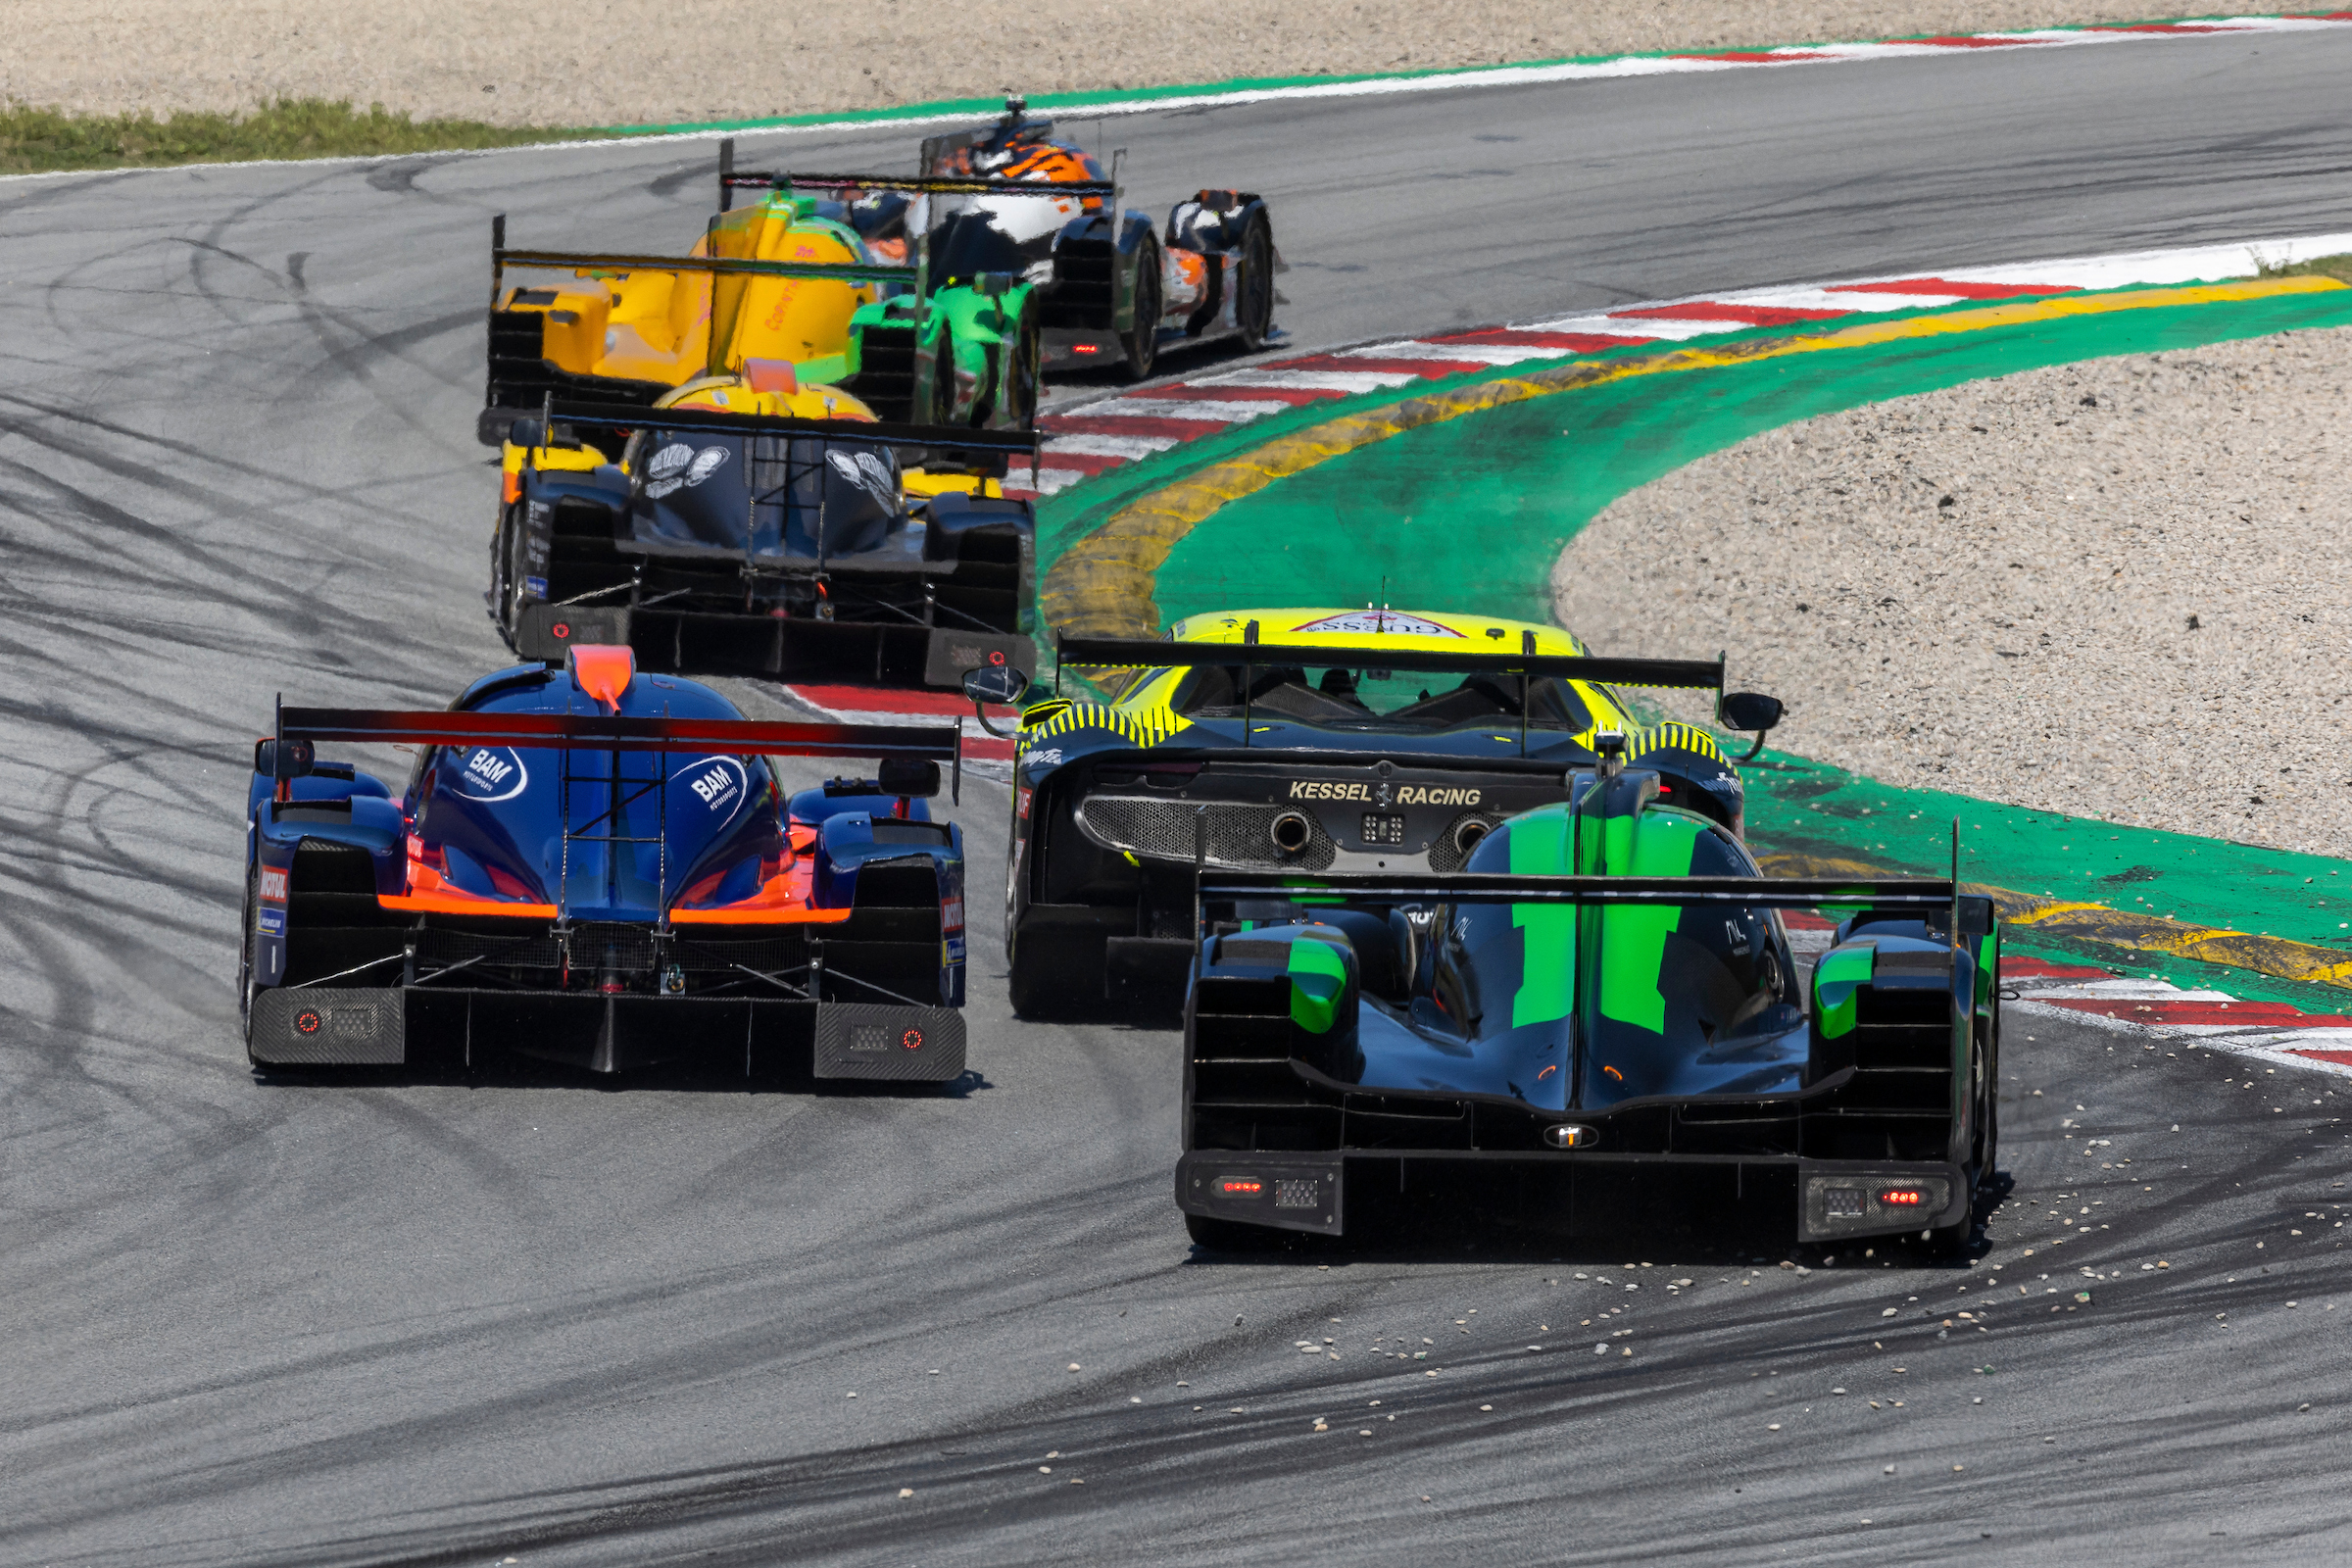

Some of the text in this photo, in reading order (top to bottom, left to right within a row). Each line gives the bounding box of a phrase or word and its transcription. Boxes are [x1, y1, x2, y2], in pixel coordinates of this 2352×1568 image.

[469, 749, 513, 783] BAM
[691, 764, 733, 803] BAM
[1289, 781, 1482, 806] KESSEL RACING
[710, 786, 738, 811] MOTORSPORTS
[260, 870, 286, 899] MOTUL
